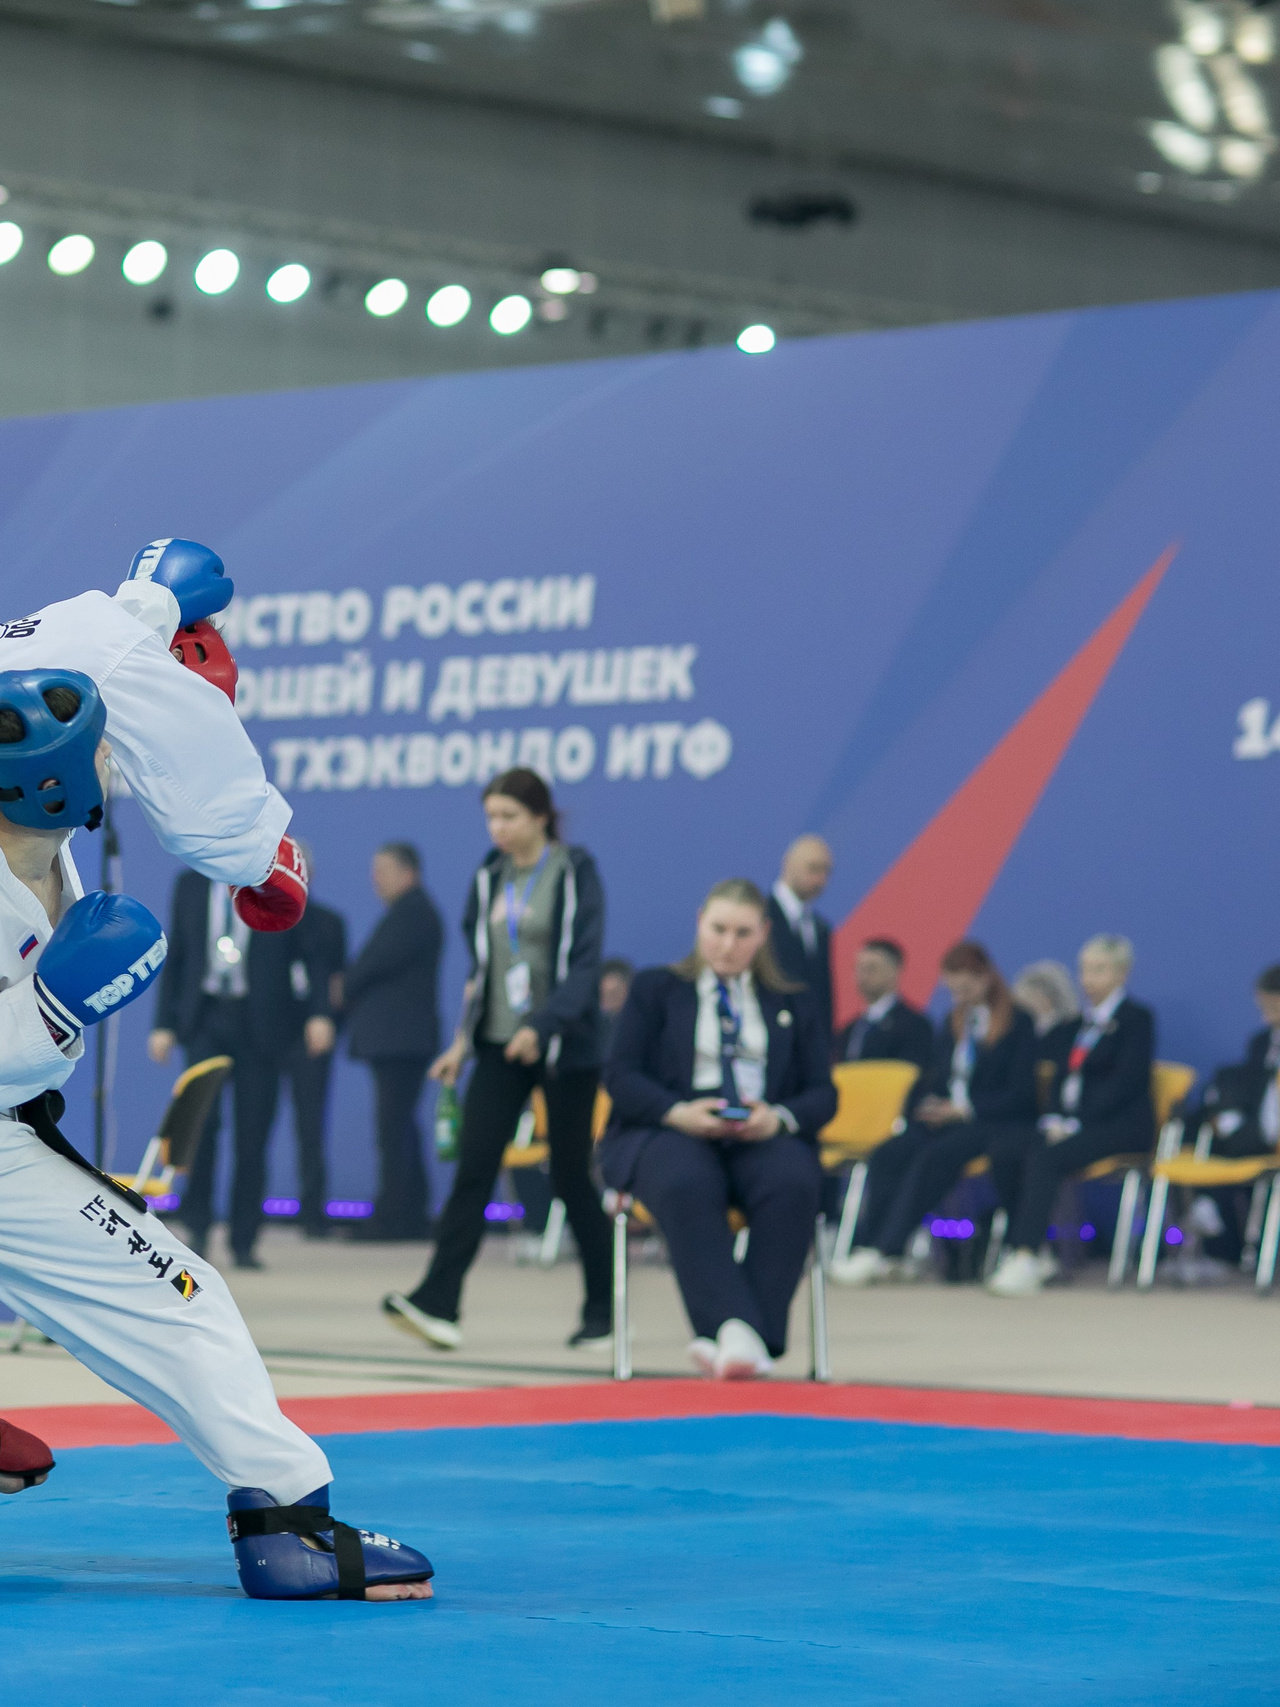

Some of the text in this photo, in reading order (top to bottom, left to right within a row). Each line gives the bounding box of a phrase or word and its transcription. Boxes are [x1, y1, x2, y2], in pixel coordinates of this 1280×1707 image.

[381, 573, 596, 641] РОССИИ
[382, 658, 424, 716] И
[429, 645, 697, 721] ДЕВУШЕК
[273, 718, 732, 790] ТХЭКВОНДО ИТФ
[1232, 697, 1280, 761] 1
[83, 973, 135, 1014] TOP
[79, 1194, 107, 1222] ITF
